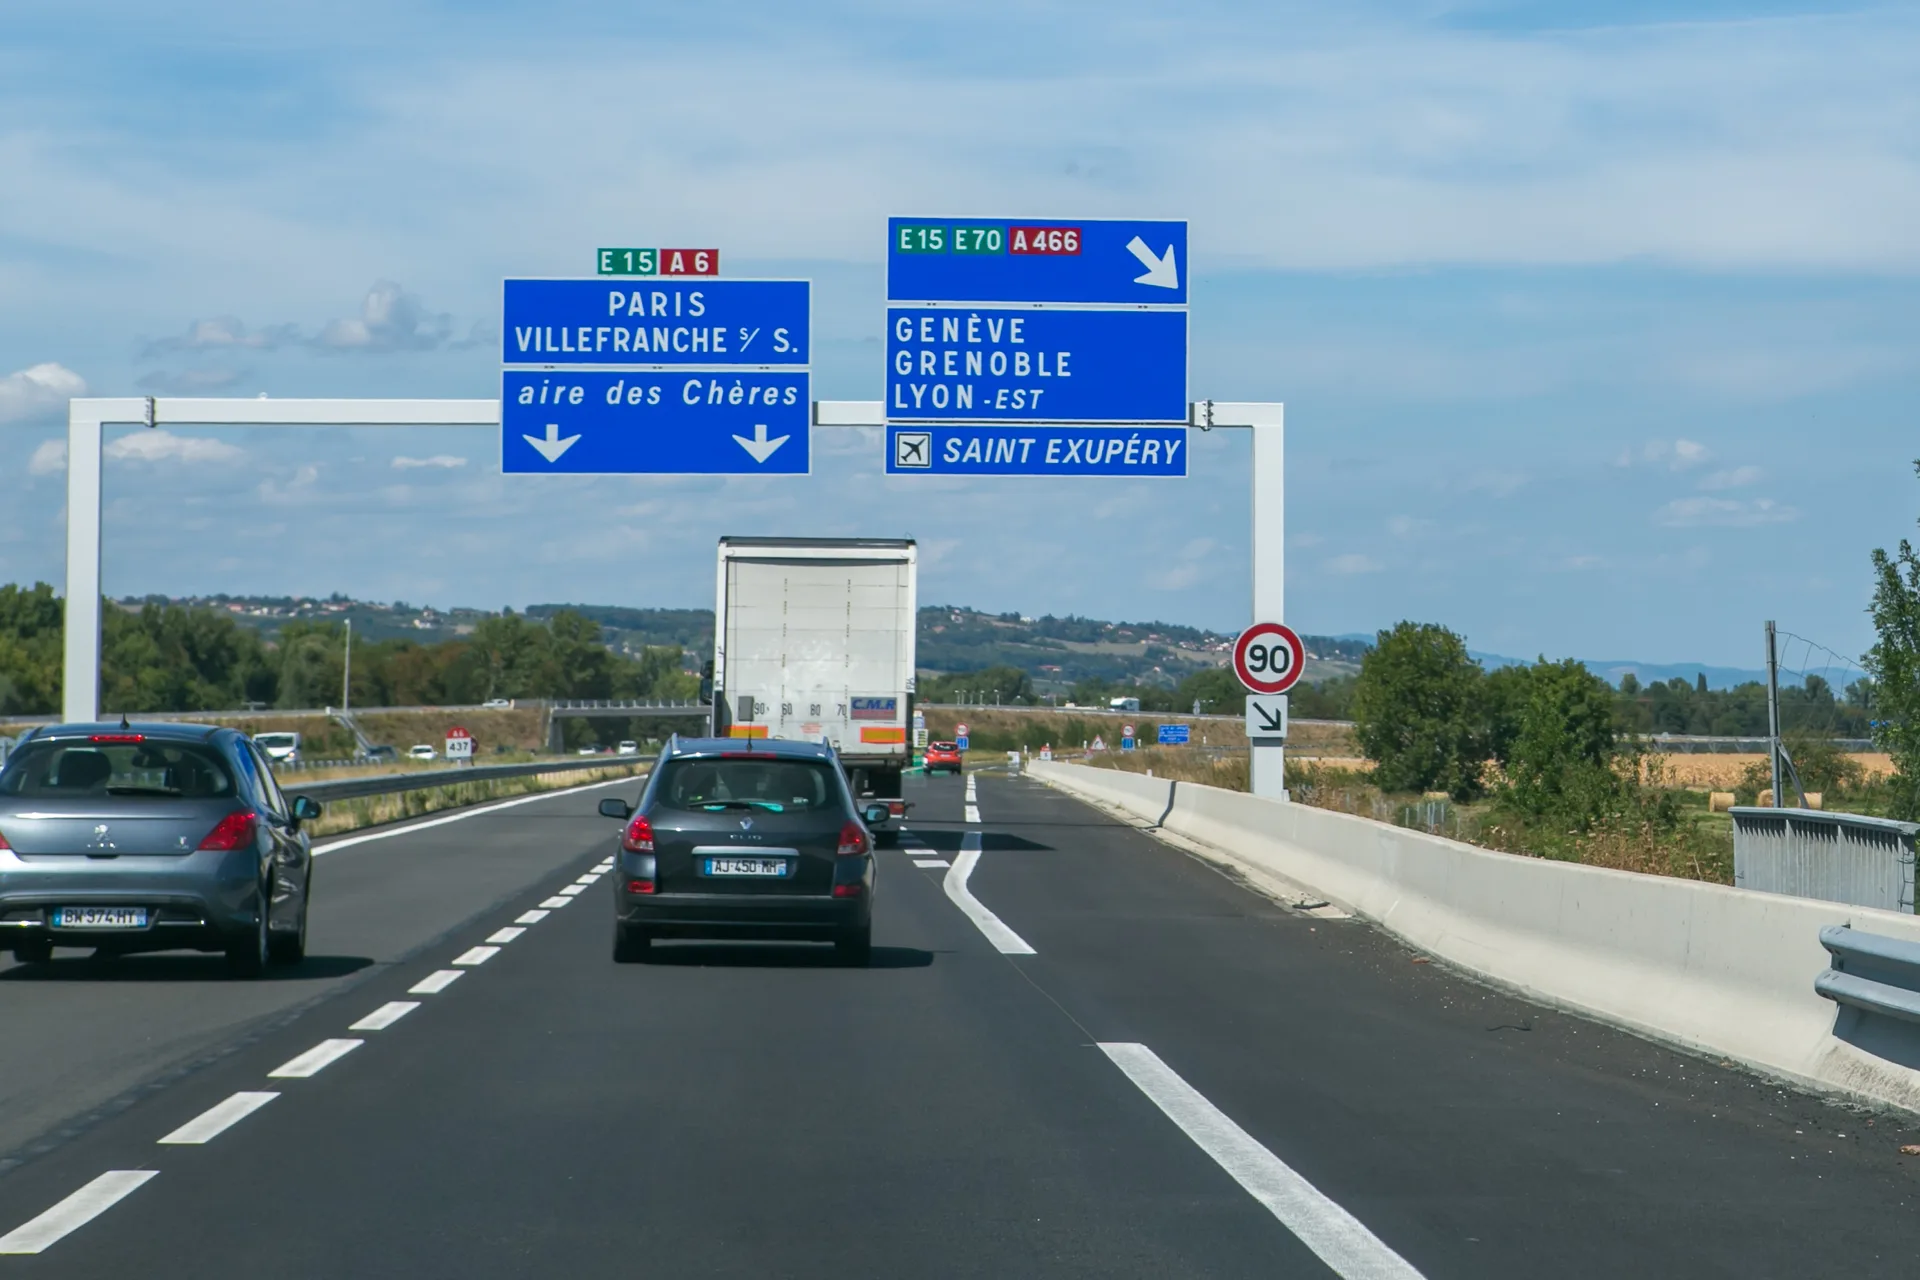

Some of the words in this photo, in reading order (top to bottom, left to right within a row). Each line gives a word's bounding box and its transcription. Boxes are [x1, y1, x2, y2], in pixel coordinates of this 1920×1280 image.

[601, 251, 613, 272] E
[623, 251, 653, 273] 15
[669, 251, 685, 273] A
[694, 251, 709, 273] 6
[609, 291, 706, 317] PARIS
[515, 326, 727, 353] VILLEFRANCHE
[773, 327, 798, 353] S.
[895, 313, 1025, 344] GENÈVE
[895, 350, 1072, 377] GRENOBLE
[518, 379, 585, 405] aire
[606, 379, 662, 405] des
[682, 379, 798, 406] Chères
[895, 383, 973, 409] LYON
[943, 437, 1036, 464] SAINT
[1045, 432, 1182, 465] EXUPÉRY
[1249, 644, 1290, 674] 90
[449, 742, 469, 751] 437
